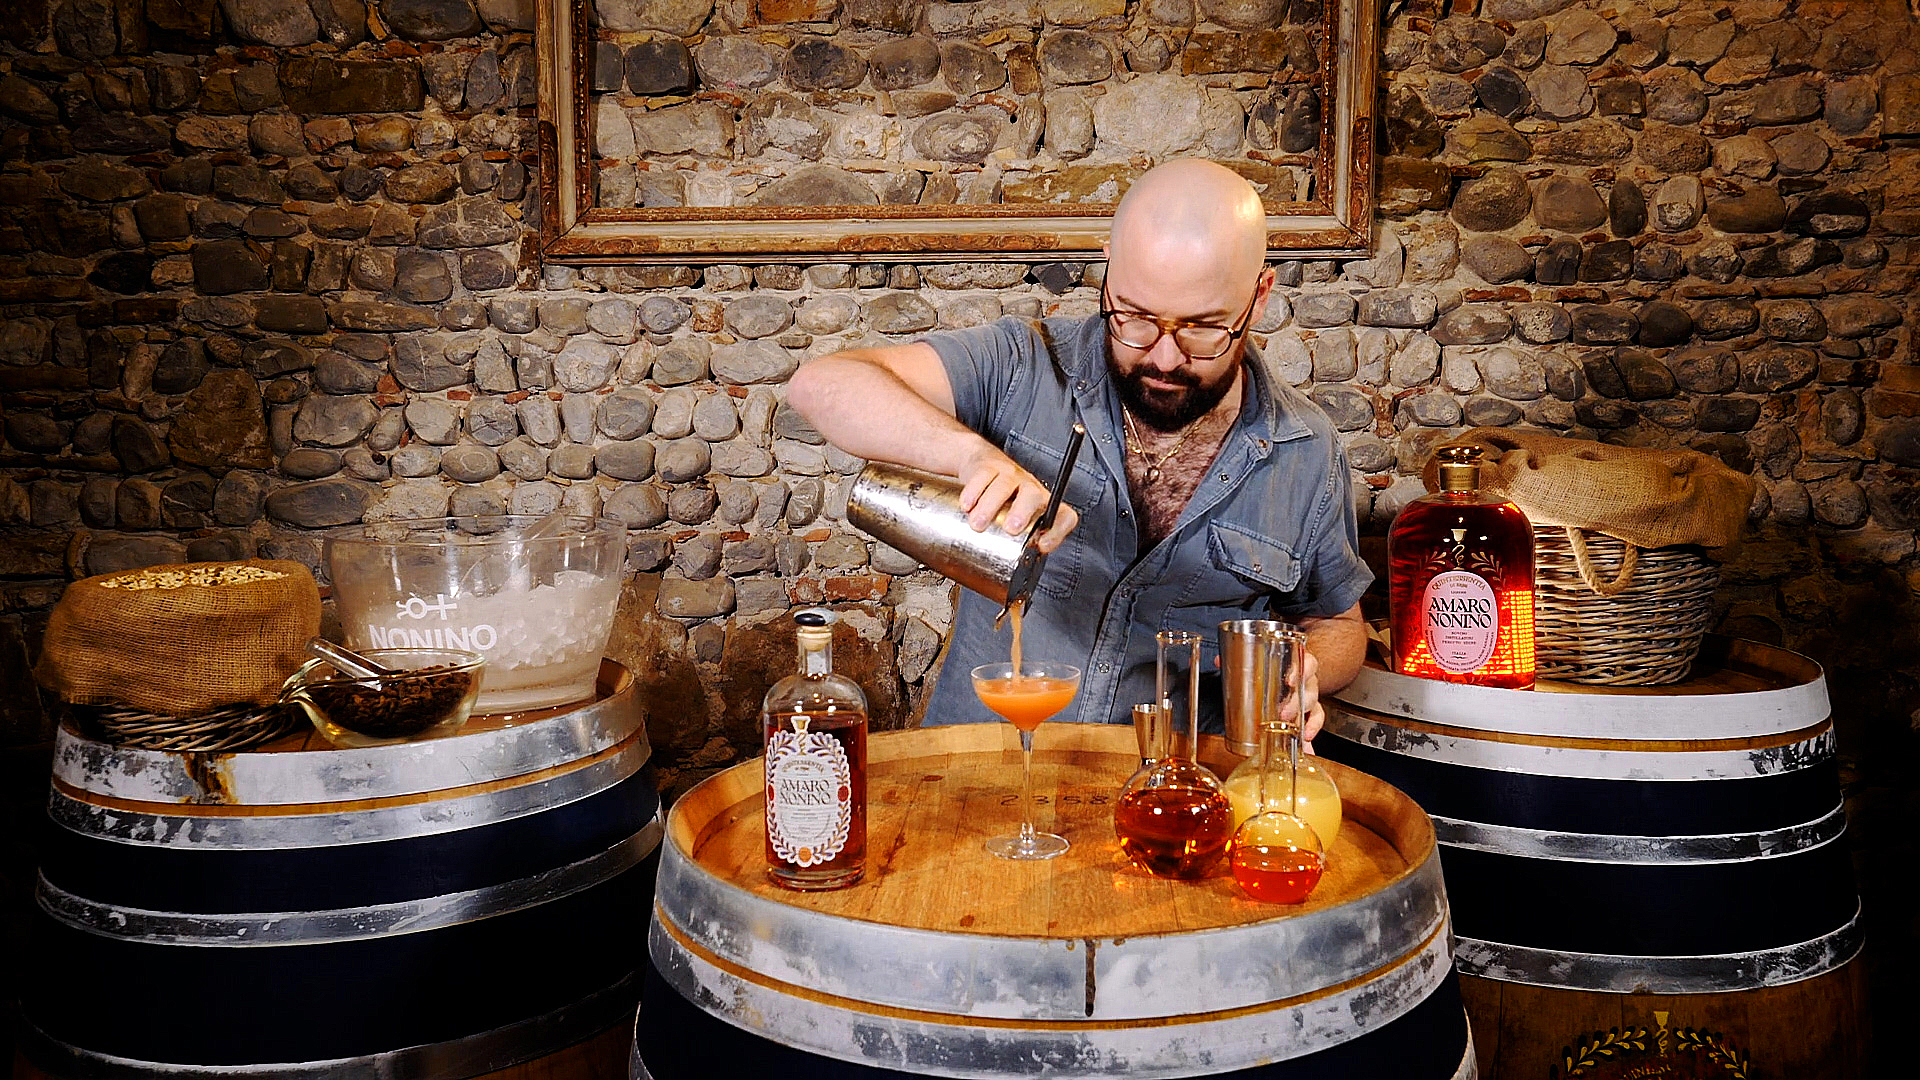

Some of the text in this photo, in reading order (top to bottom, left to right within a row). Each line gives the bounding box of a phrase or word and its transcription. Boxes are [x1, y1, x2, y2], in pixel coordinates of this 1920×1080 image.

[1428, 597, 1491, 613] AMARO
[1428, 612, 1492, 629] NONINO
[368, 624, 498, 651] NONINO
[781, 779, 831, 793] AMARO
[779, 791, 831, 805] NONINO
